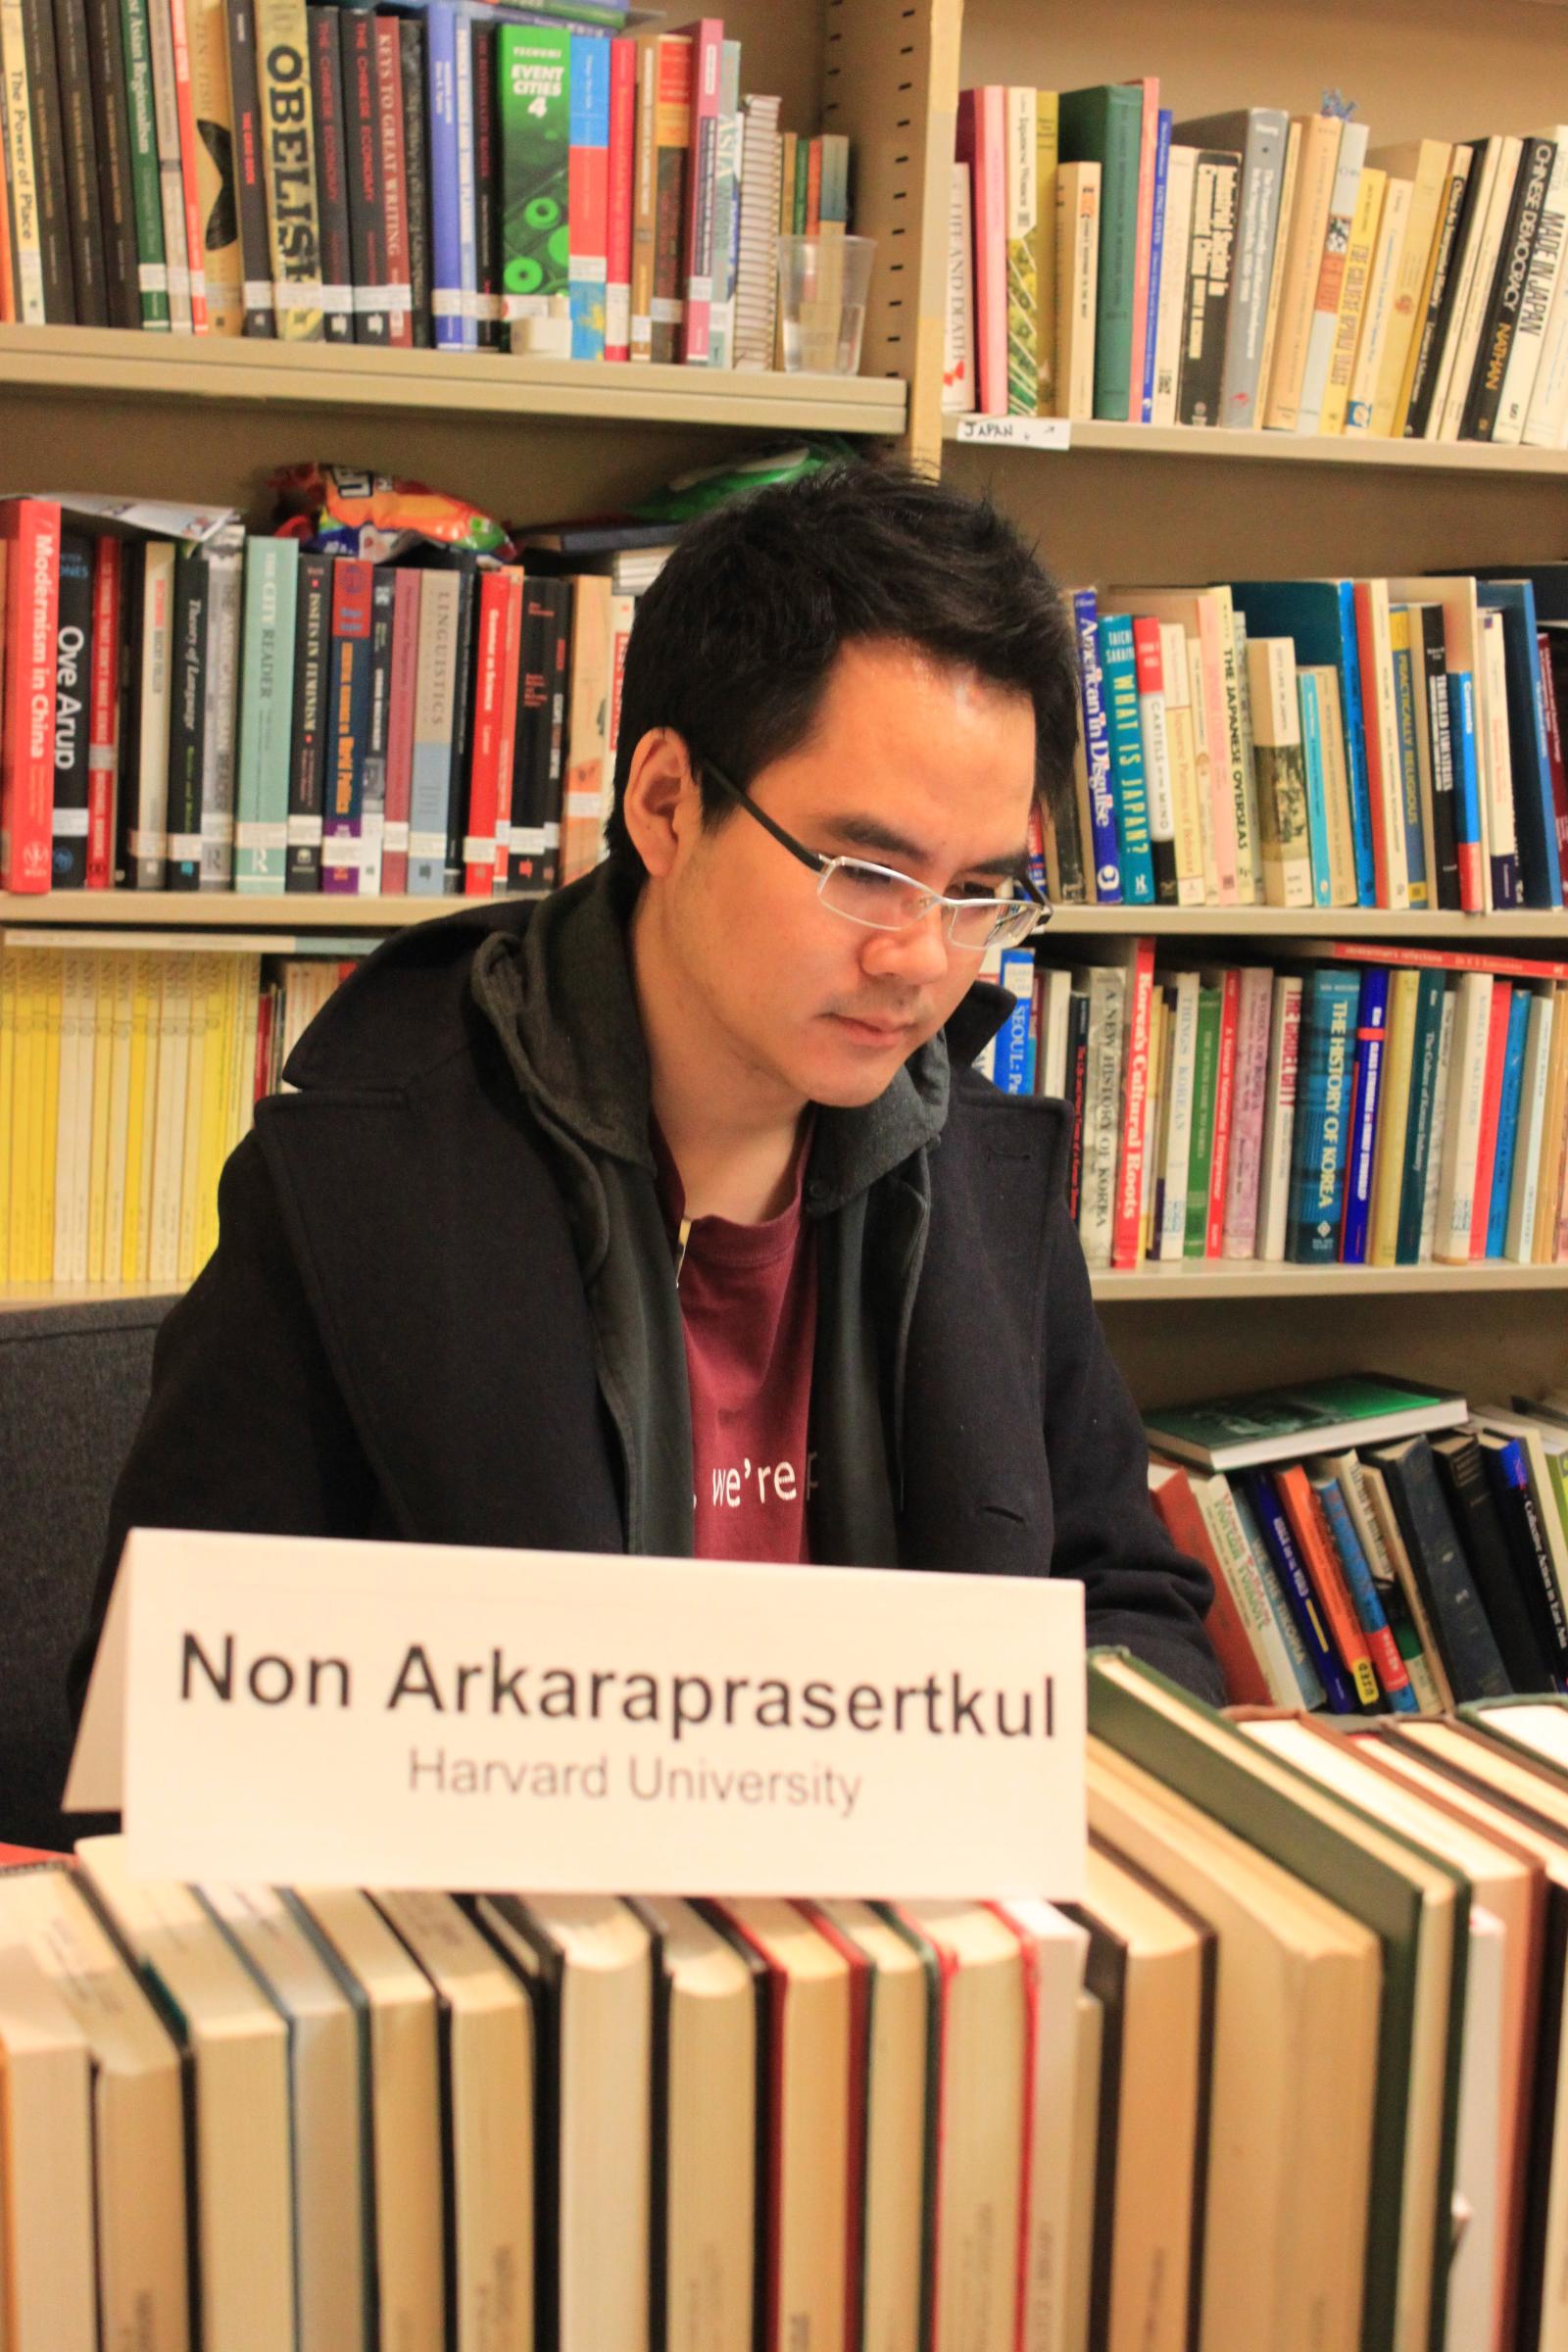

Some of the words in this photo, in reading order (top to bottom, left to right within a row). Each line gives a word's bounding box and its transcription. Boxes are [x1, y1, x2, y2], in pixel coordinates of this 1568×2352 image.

[376, 32, 394, 79] KEYS
[511, 64, 564, 81] EVENT
[10, 71, 23, 102] The
[379, 80, 396, 109] TO
[513, 80, 563, 97] CITIES
[527, 96, 548, 118] 4
[12, 109, 28, 166] Power
[381, 112, 400, 174] GREAT
[19, 168, 29, 185] of
[1019, 165, 1028, 207] Women
[1526, 142, 1550, 211] CHINESE
[19, 191, 33, 241] Place
[952, 202, 963, 243] LIFE
[1536, 208, 1563, 260] MADE
[951, 245, 964, 290] AND
[1348, 242, 1369, 264] THE
[1504, 209, 1537, 313] DEMOCRACY
[1530, 259, 1553, 280] IN
[1342, 265, 1365, 313] CHINESE
[1518, 277, 1548, 336] JAPAN
[951, 295, 965, 363] DEATH
[1336, 312, 1357, 351] OPIUM
[1485, 320, 1510, 391] NATHAN
[963, 420, 1013, 437] JAPAN
[31, 533, 51, 663] Modernism
[185, 598, 201, 645] Theory
[262, 580, 277, 625] CITY
[56, 625, 83, 687] Ove
[185, 646, 199, 662] of
[307, 640, 319, 658] IN
[486, 609, 498, 655] Grammar
[31, 667, 47, 690] in
[259, 628, 274, 699] READER
[431, 589, 450, 726] LINGUISTICS
[486, 656, 495, 669] as
[1080, 615, 1104, 712] American
[1221, 648, 1235, 683] THE
[183, 664, 199, 730] Language
[303, 662, 318, 731] FEMINISM
[483, 670, 495, 711] Science
[1113, 672, 1137, 731] WHAT
[1396, 653, 1413, 746] PRACTICALLY
[30, 693, 47, 760] China
[53, 691, 80, 771] Arup
[1088, 710, 1107, 738] in
[1150, 700, 1165, 762] CARTELS
[1224, 684, 1242, 764] JAPANESE
[1119, 743, 1140, 766] IS
[1087, 738, 1114, 828] Disguise
[1403, 750, 1419, 826] RELIGIOUS
[1121, 777, 1148, 855] JAPAN?
[1156, 792, 1168, 831] MIND
[1231, 769, 1250, 851] OVERSEAS
[1104, 989, 1116, 1002] A
[1133, 971, 1151, 1052] Korea's
[1254, 992, 1267, 1044] WOMEN
[1284, 989, 1300, 1018] THE
[1330, 998, 1348, 1035] THE
[1007, 1004, 1026, 1071] SEOUL:
[1102, 1007, 1116, 1047] NEW
[1178, 997, 1194, 1055] THINGS
[1223, 1026, 1233, 1035] A
[1281, 1020, 1298, 1070] CRUEL
[1424, 1031, 1434, 1050] The
[1220, 1038, 1232, 1074] Korean
[1253, 1045, 1264, 1061] OF
[1324, 1036, 1345, 1115] HISTORY
[1100, 1053, 1115, 1131] HISTORY
[1127, 1054, 1147, 1149] Cultural
[1173, 1064, 1189, 1130] KOREAN
[1250, 1064, 1263, 1112] KOREA
[1279, 1072, 1296, 1107] CITY
[1098, 1136, 1111, 1158] OF
[1322, 1115, 1339, 1145] OF
[1095, 1166, 1110, 1228] KOREA
[1122, 1152, 1142, 1220] Roots
[1317, 1145, 1337, 1209] KOREA
[711, 1457, 798, 1508] we're
[1546, 1589, 1556, 1603] in
[180, 1631, 351, 1708] Non
[385, 1644, 1056, 1741] Arkaraprasertkul
[407, 1747, 612, 1800] Harvard
[627, 1755, 863, 1819] University
